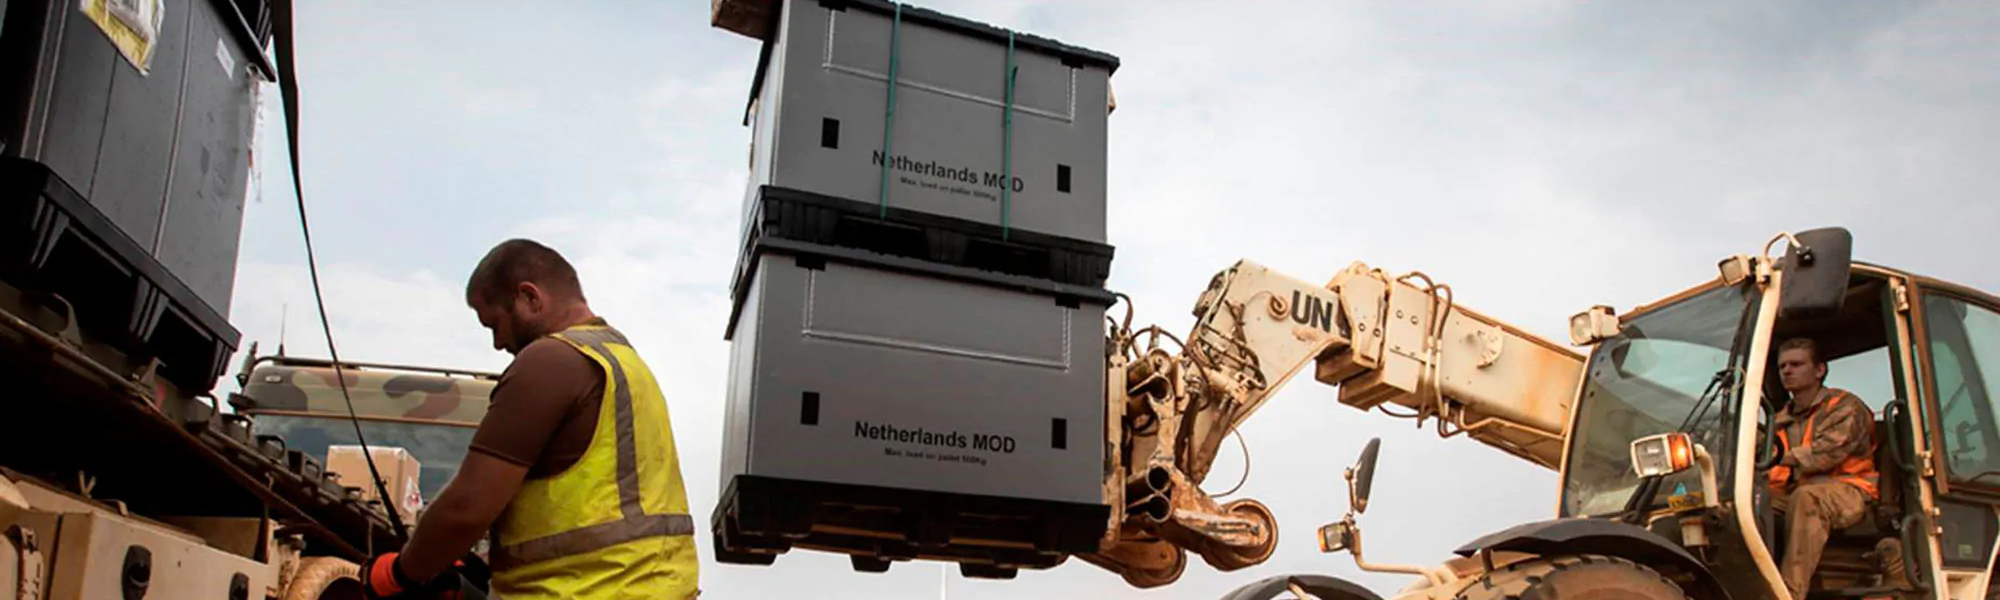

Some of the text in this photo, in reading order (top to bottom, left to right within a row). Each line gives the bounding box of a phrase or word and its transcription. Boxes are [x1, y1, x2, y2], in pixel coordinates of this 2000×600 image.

[872, 150, 979, 184] Netherlands
[1291, 289, 1333, 333] UN
[854, 421, 1016, 454] Netherlands MOD
